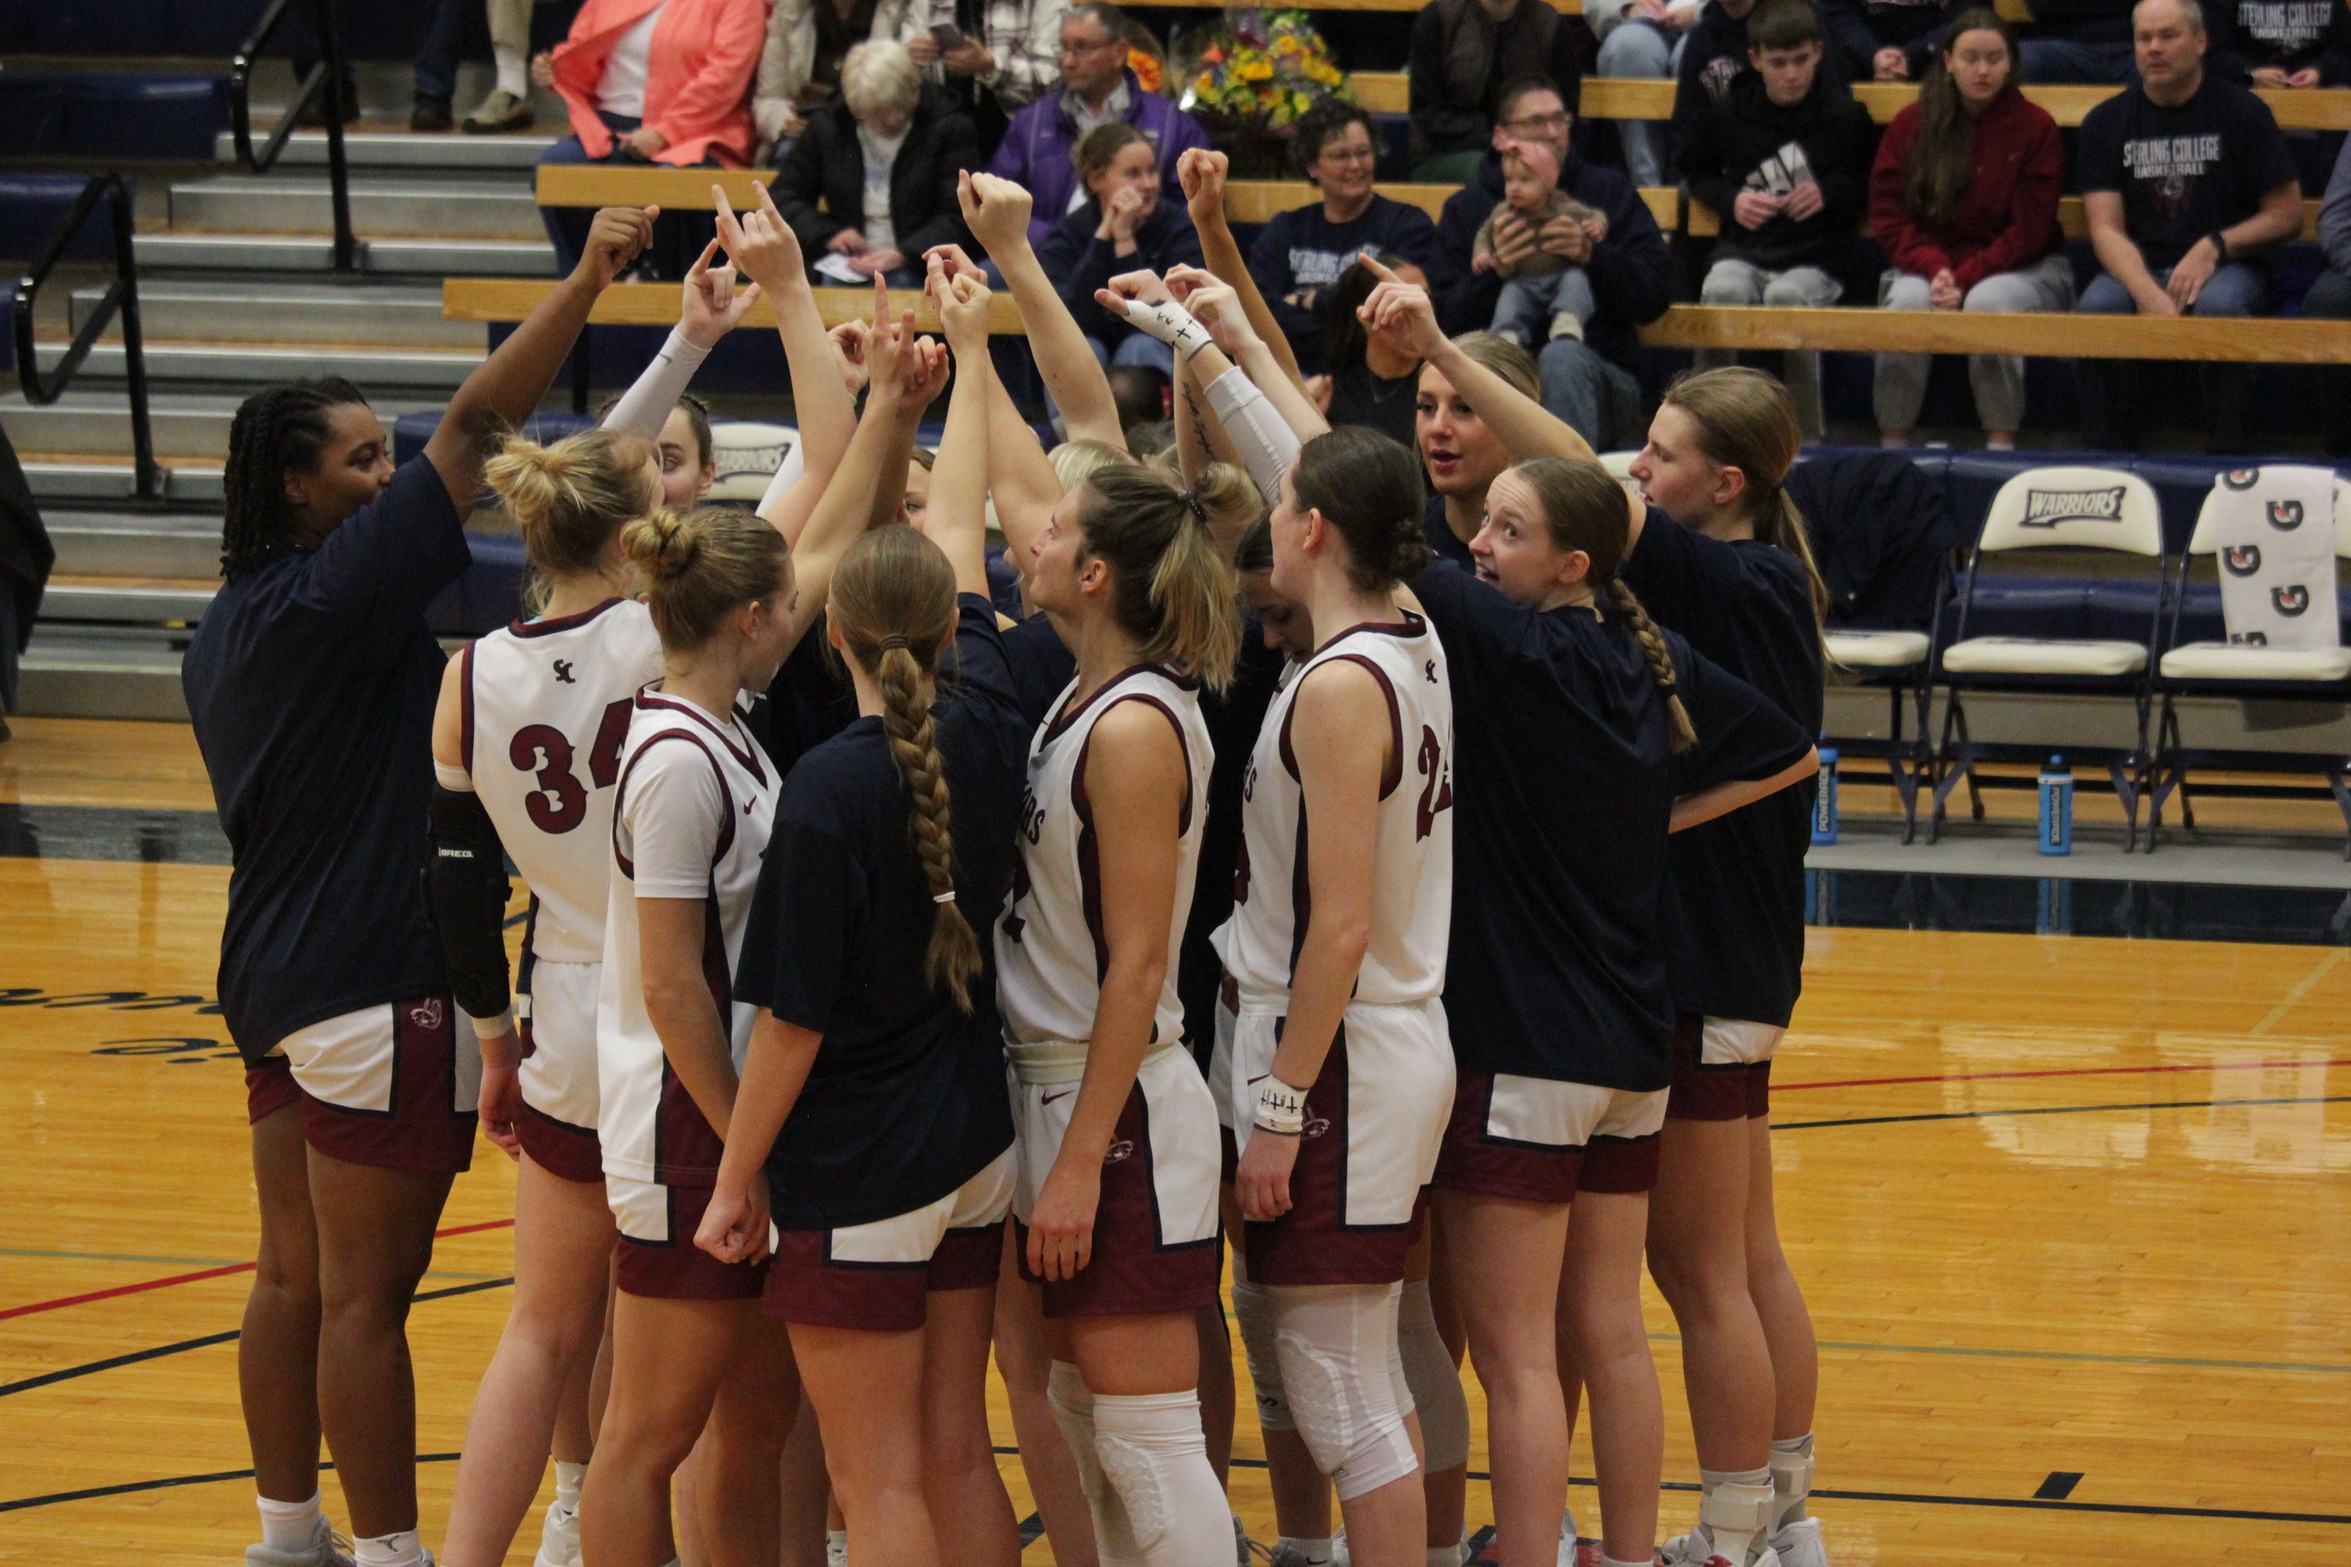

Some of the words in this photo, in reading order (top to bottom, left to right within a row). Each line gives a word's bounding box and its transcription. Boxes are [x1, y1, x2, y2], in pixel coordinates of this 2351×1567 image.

[2288, 2, 2331, 27] COLLEGE
[2172, 135, 2220, 163] COLLEGE
[2028, 488, 2123, 519] WARRIORS
[1818, 764, 1830, 832] POWERADE
[2050, 786, 2061, 844] POWERADE
